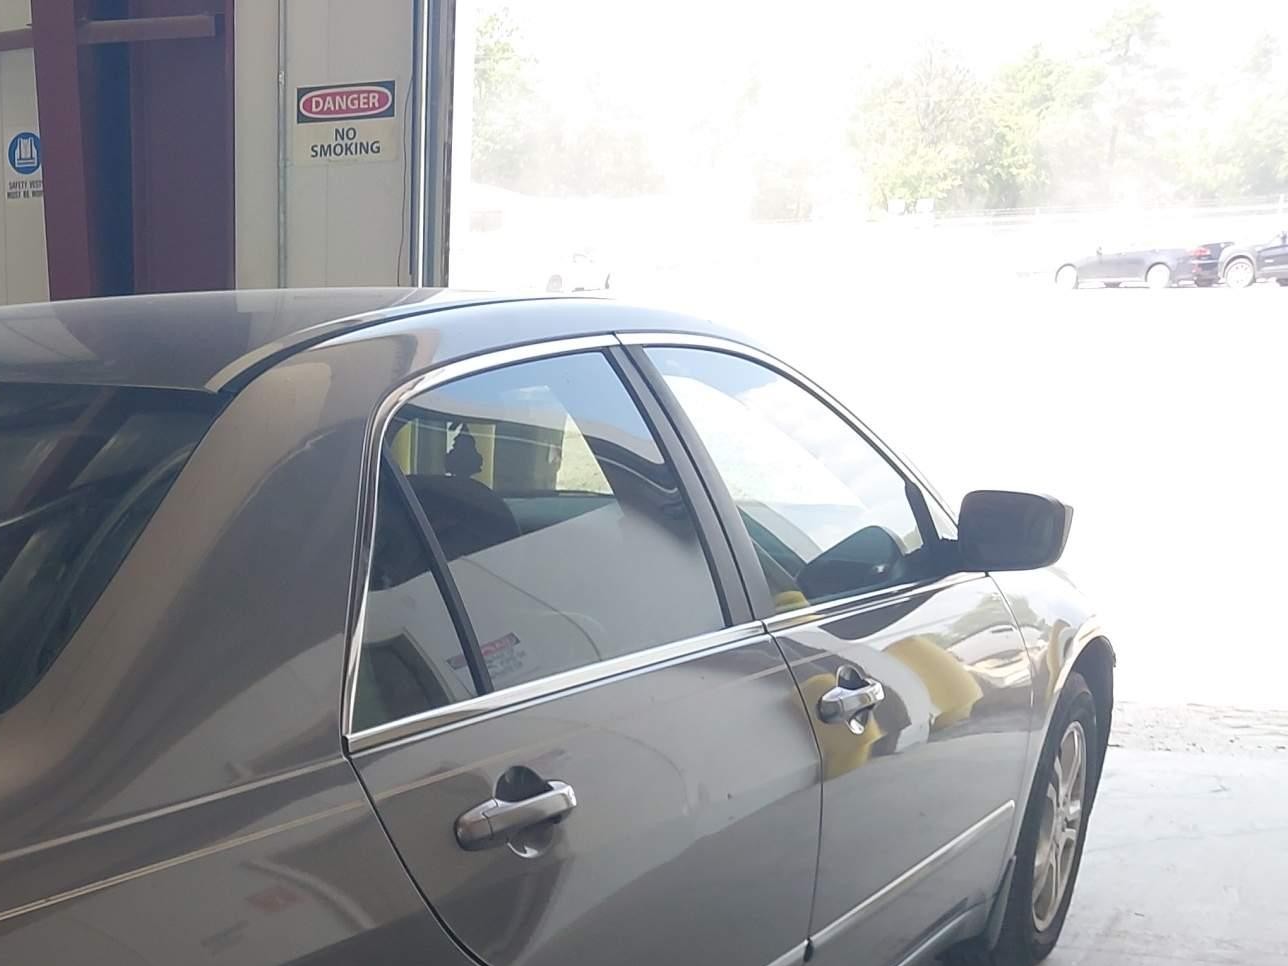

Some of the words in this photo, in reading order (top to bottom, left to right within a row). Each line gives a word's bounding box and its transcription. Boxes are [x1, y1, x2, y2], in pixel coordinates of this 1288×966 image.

[311, 92, 379, 112] DANGER
[334, 127, 357, 141] NO
[310, 140, 381, 158] SMOKING
[8, 180, 27, 190] SAFETY
